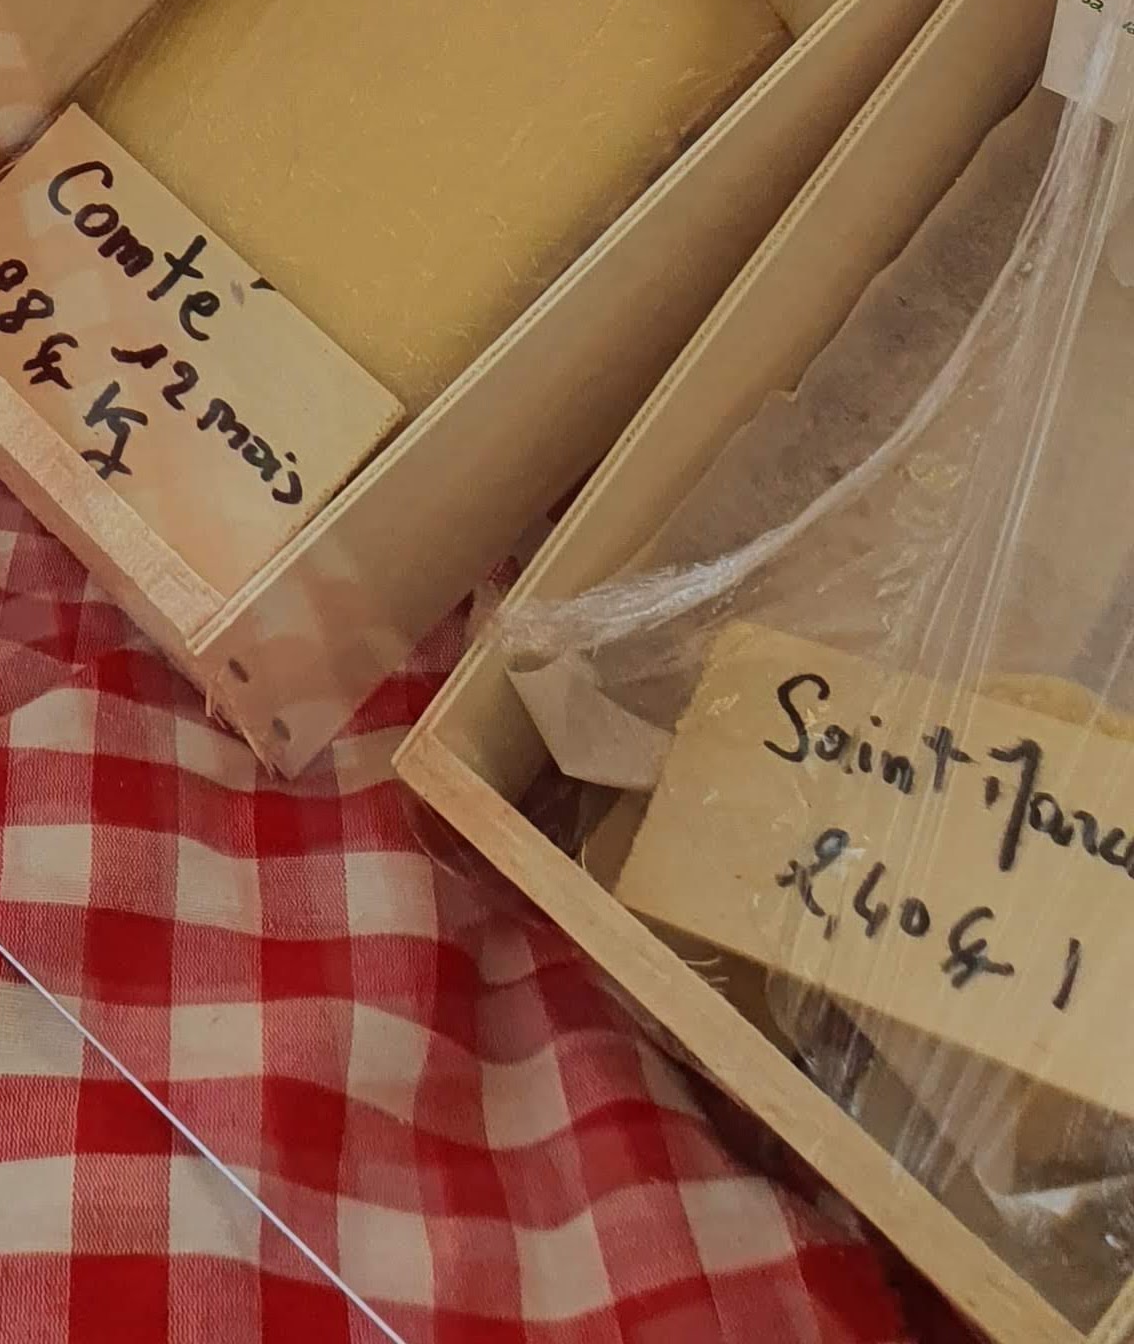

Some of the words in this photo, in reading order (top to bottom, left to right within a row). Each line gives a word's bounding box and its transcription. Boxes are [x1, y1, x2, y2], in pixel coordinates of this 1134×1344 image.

[48, 160, 277, 342] Comté
[764, 673, 979, 796] Saint
[983, 738, 1134, 881] Marc
